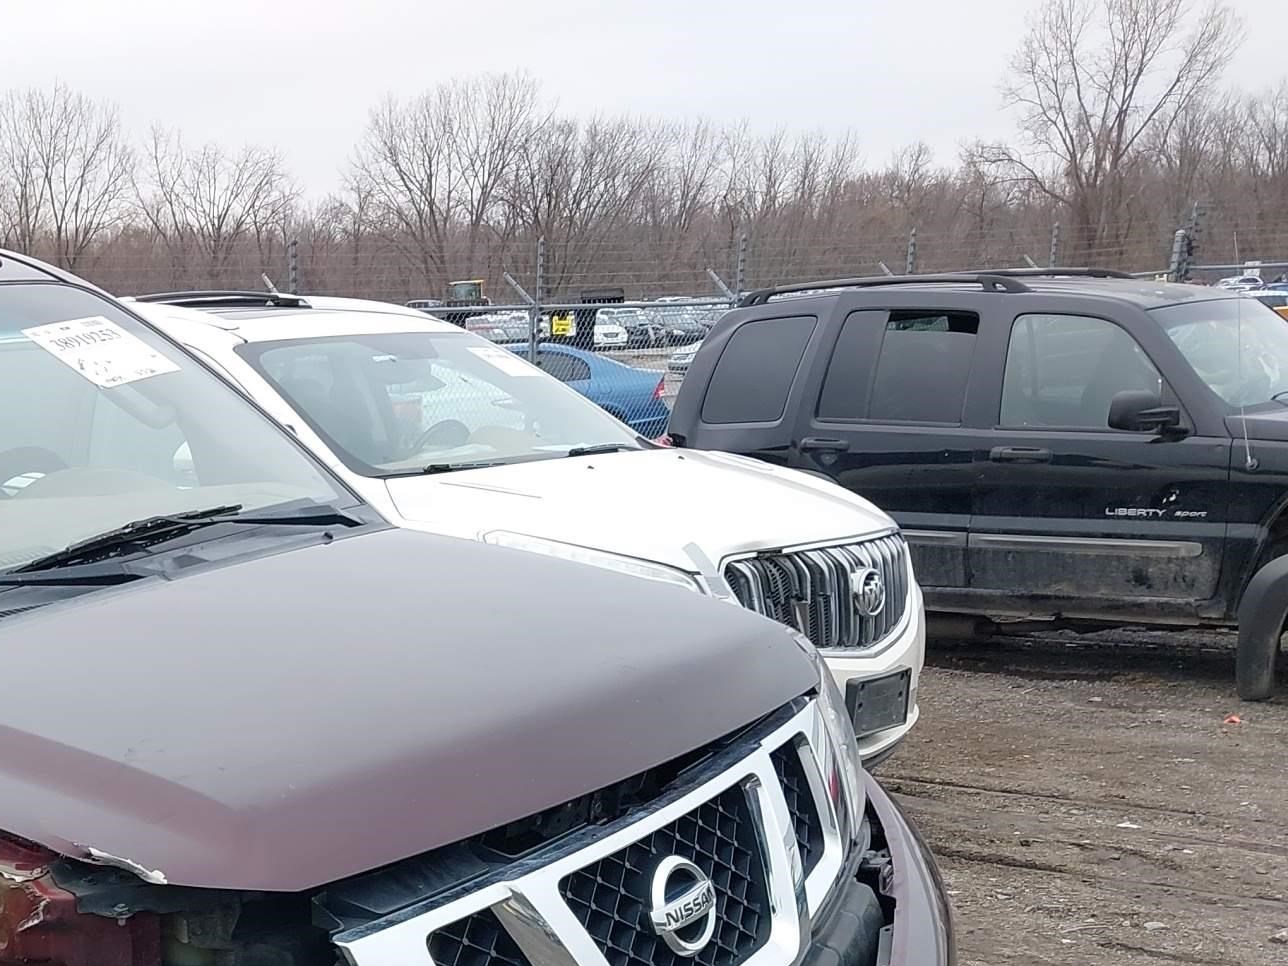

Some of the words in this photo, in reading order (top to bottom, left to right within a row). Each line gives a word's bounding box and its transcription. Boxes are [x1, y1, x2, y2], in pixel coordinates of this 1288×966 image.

[49, 328, 122, 352] 38919253
[1105, 507, 1167, 517] LIBERTY
[665, 886, 713, 927] NISSAN
